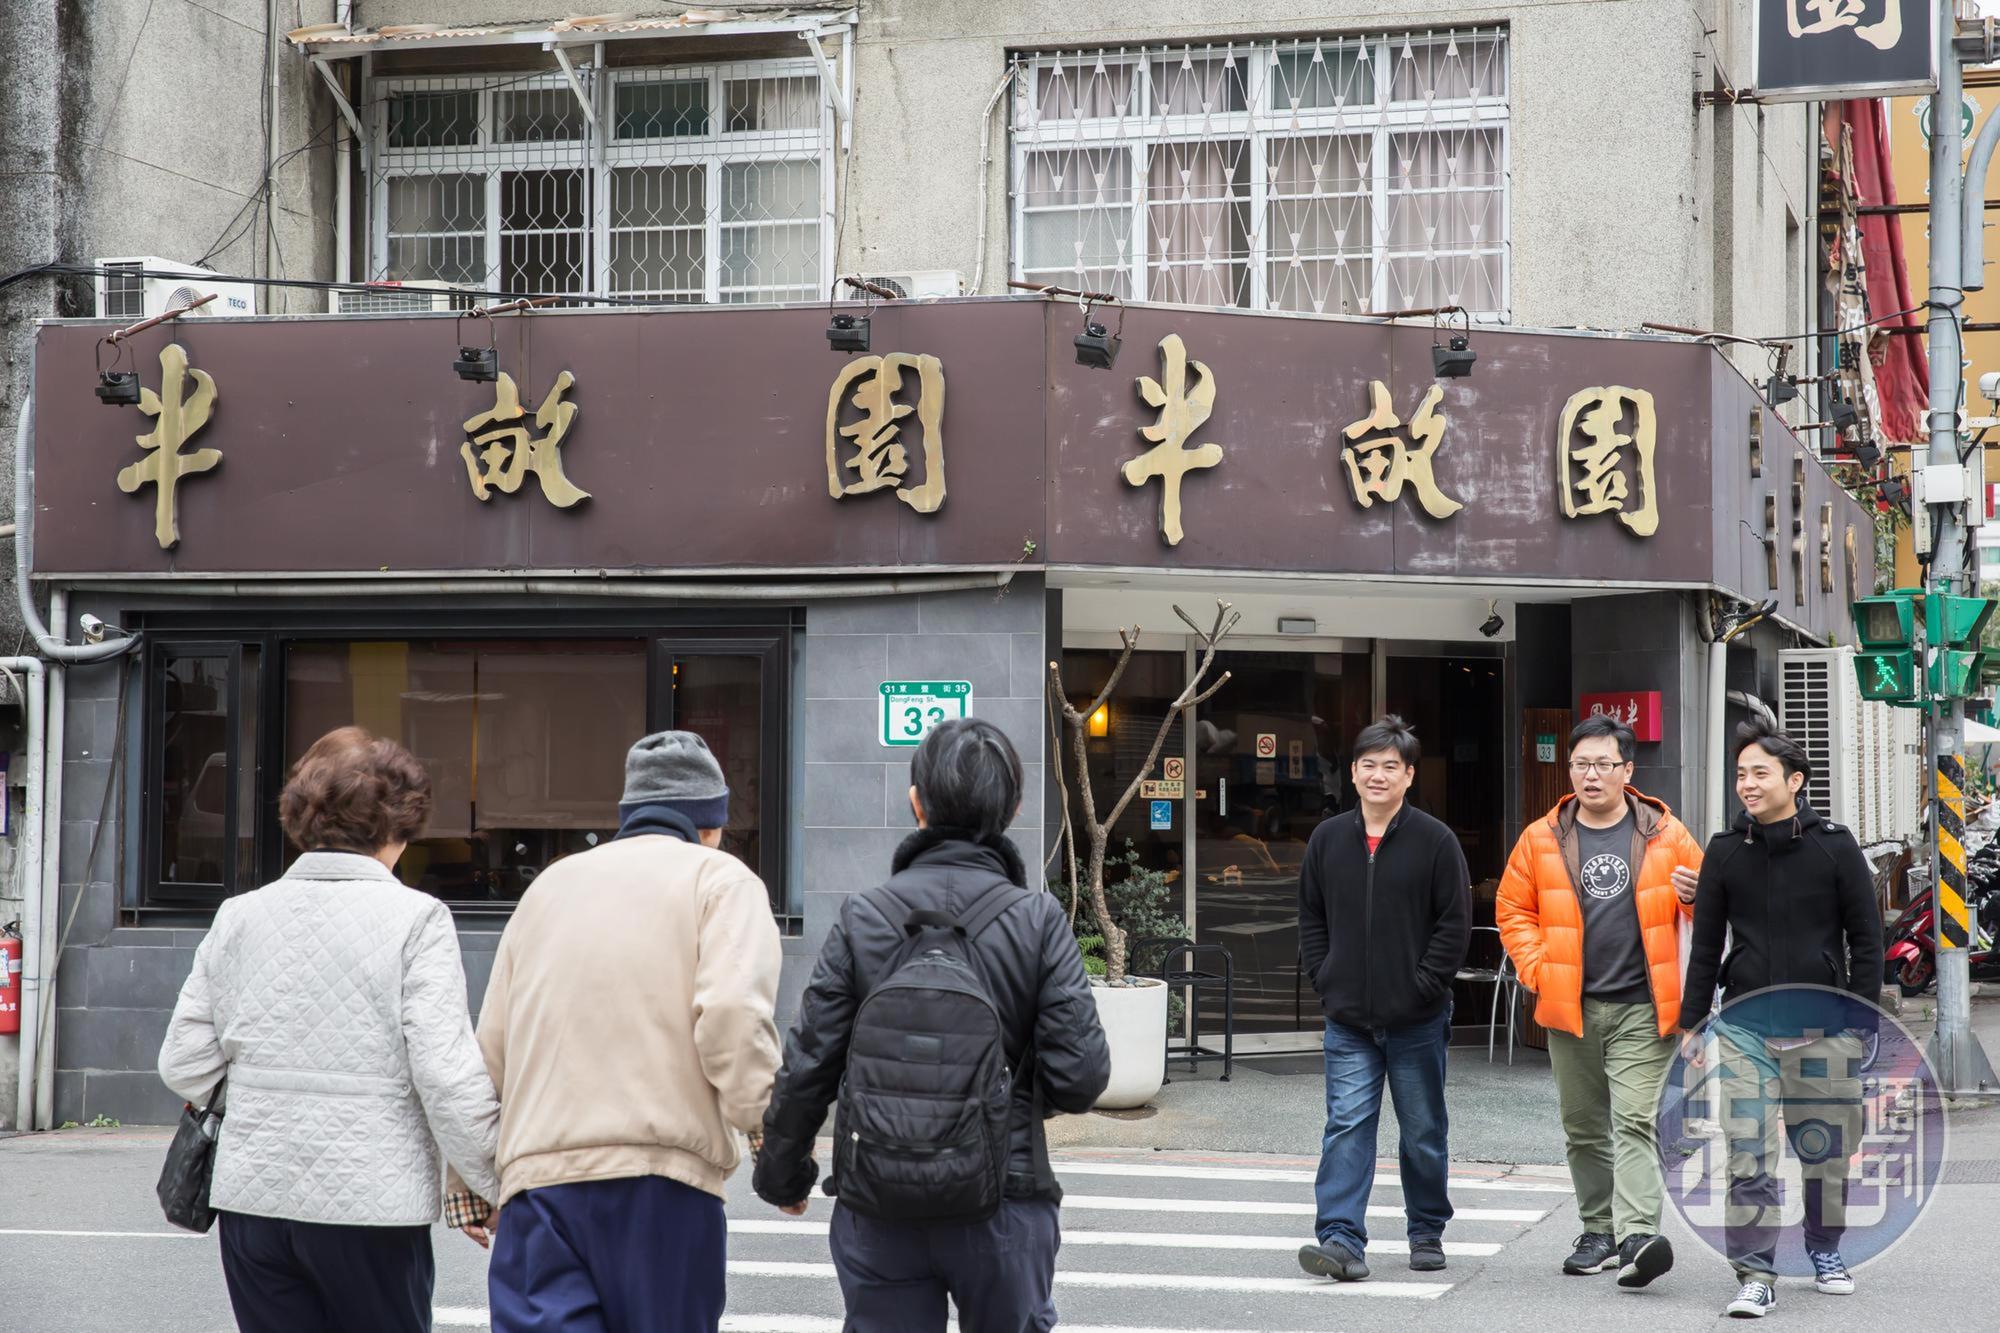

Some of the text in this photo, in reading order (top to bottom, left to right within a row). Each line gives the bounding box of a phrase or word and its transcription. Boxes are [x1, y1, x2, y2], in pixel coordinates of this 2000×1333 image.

[228, 297, 247, 309] TECO
[117, 343, 947, 550] 半畝園
[1121, 333, 1661, 546] 半畝園
[884, 685, 896, 693] 31
[954, 684, 967, 693] 35
[1540, 746, 1552, 760] 33
